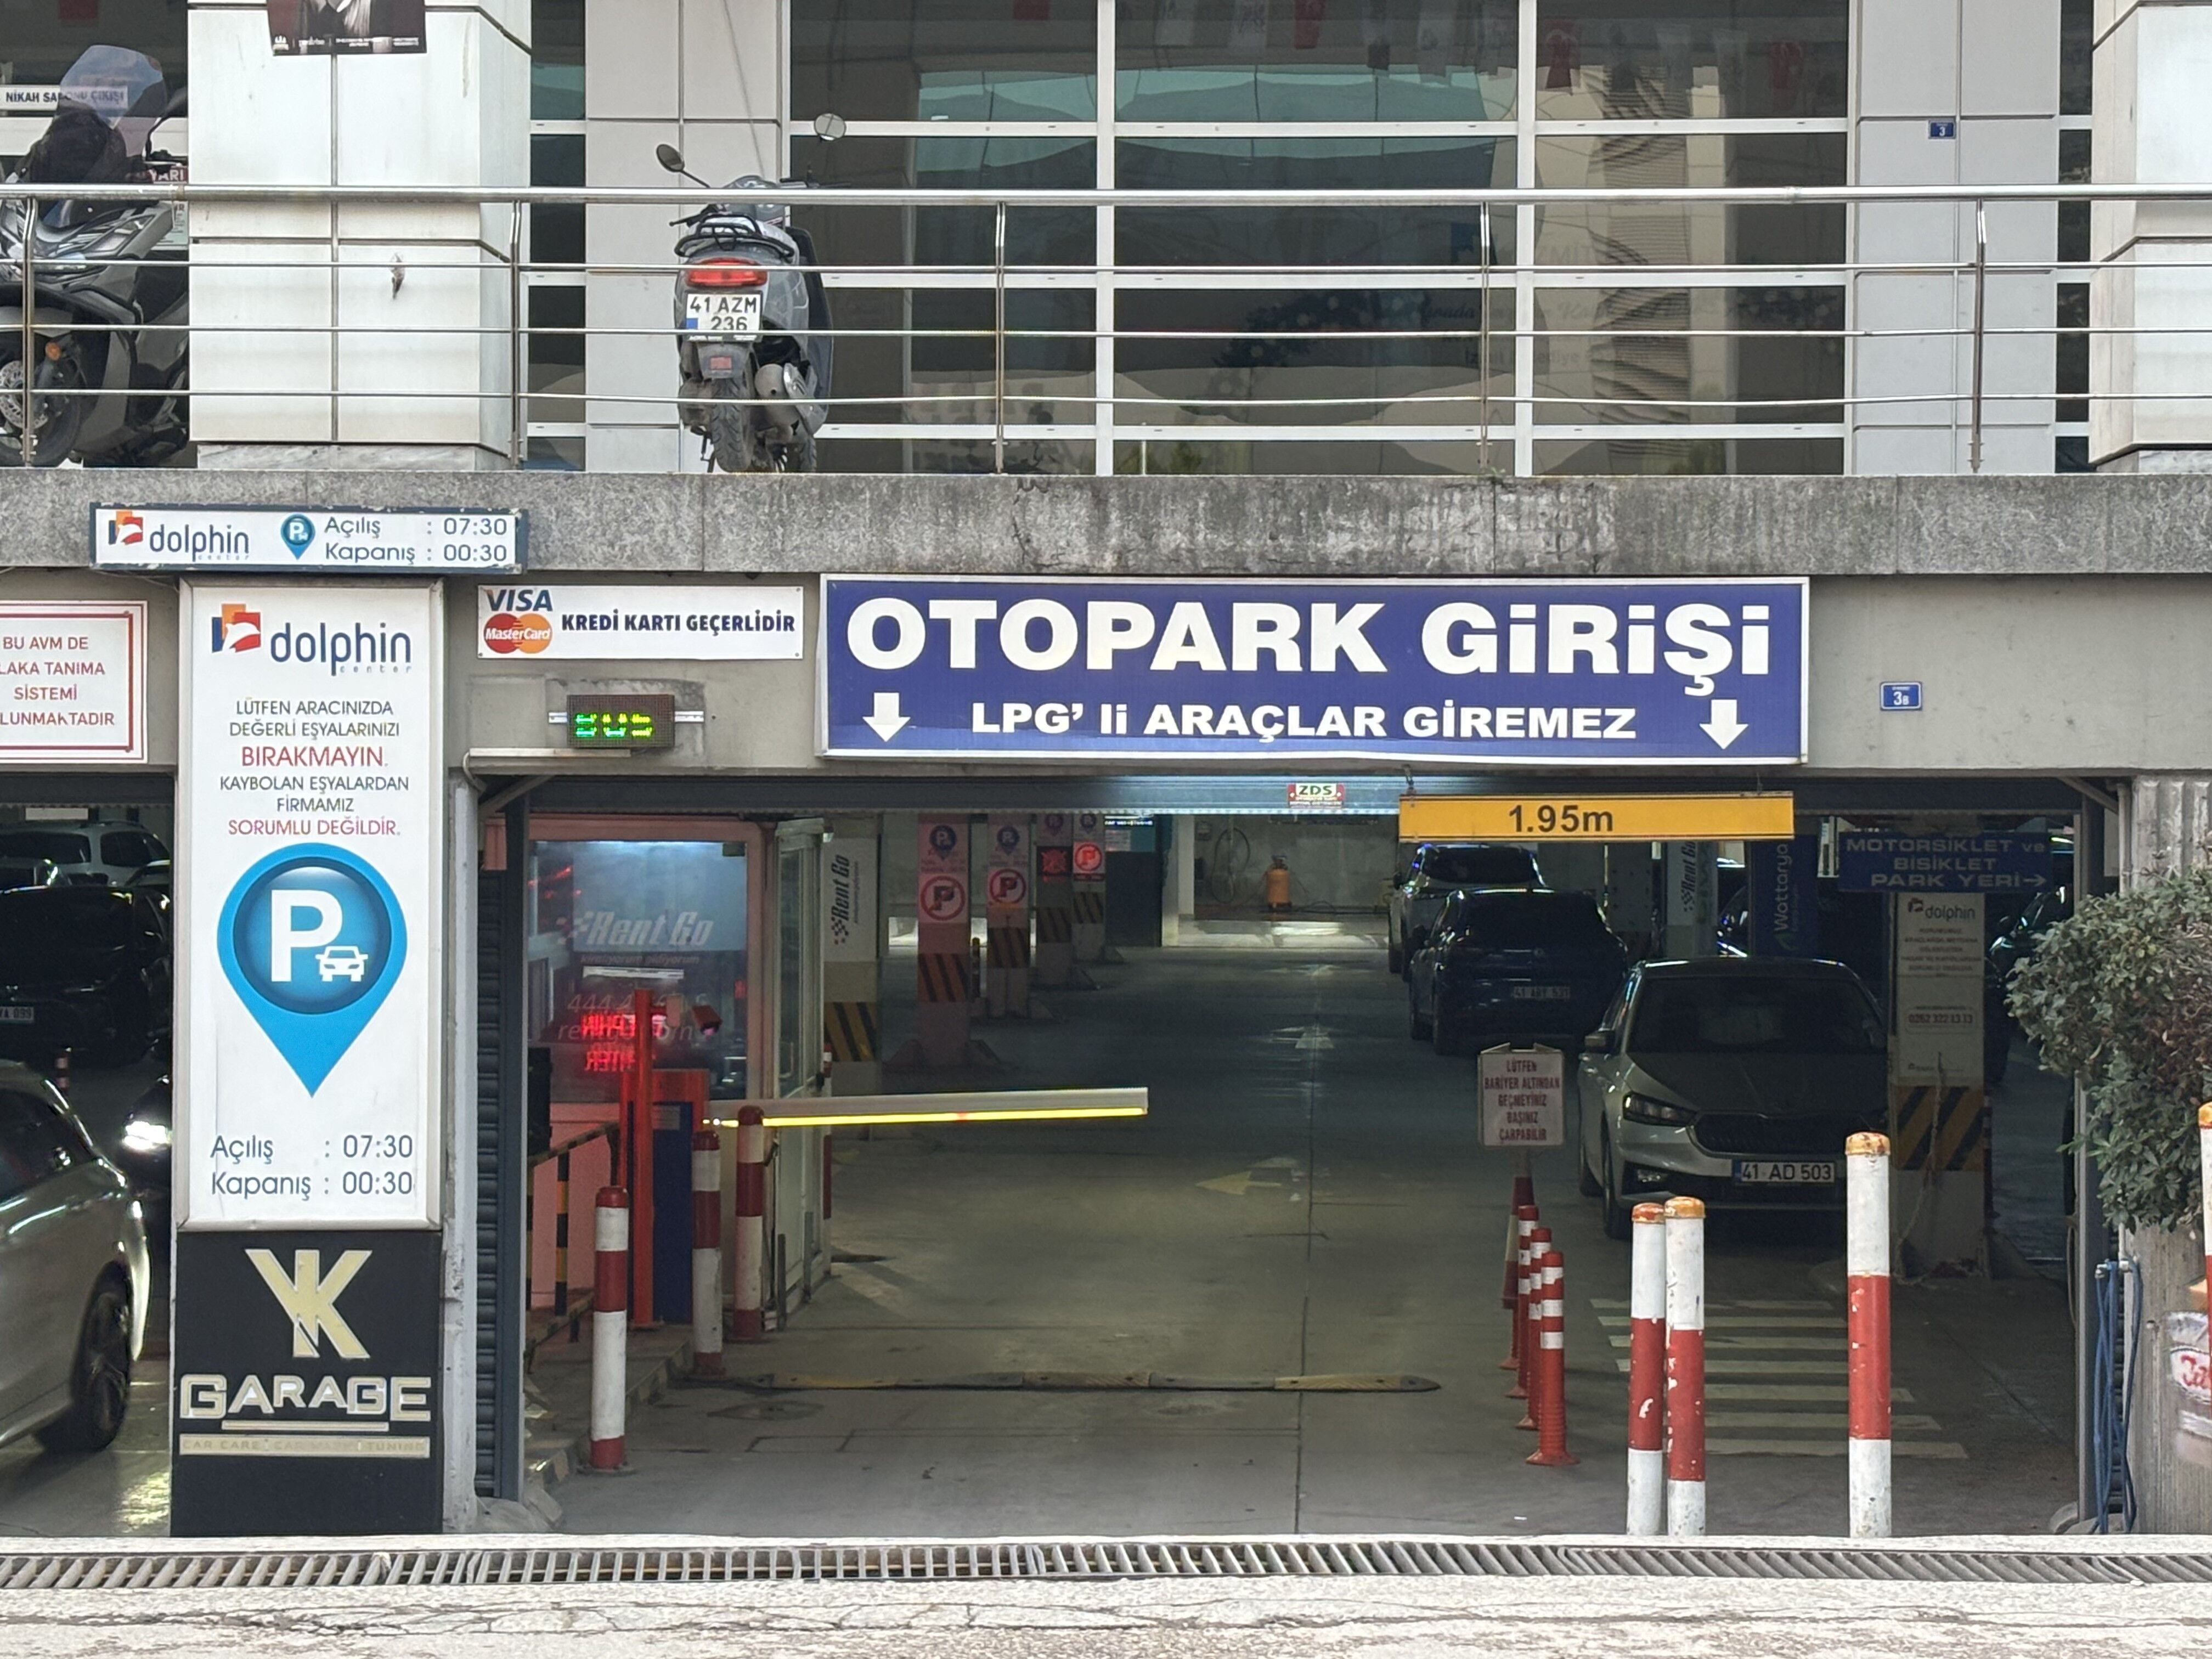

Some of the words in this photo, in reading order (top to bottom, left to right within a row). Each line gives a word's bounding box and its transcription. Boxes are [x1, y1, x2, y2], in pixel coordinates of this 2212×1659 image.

[6, 89, 40, 102] NİKAH
[690, 296, 710, 313] 41
[718, 296, 757, 314] AZM
[710, 316, 748, 330] 236
[324, 517, 381, 538] Açılış
[443, 517, 507, 536] 07:30
[149, 524, 249, 561] dolphin
[325, 542, 415, 564] Kapanış
[443, 544, 507, 562] 00:30
[484, 589, 553, 612] VISA
[561, 608, 619, 631] KREDİ
[624, 613, 680, 631] KARTI
[686, 608, 795, 636] GEÇERLİDİR
[485, 627, 551, 640] MasterCard
[847, 596, 1387, 673] OTOPARK
[3, 636, 25, 650] BU
[29, 636, 63, 650] AVM
[67, 636, 89, 650] DE
[270, 622, 411, 677] dolphin
[44, 662, 105, 675] TANIMA
[340, 664, 412, 674] center
[14, 684, 77, 700] SİSTEMİ
[236, 697, 290, 715] LÜTFEN
[296, 701, 393, 715] ARACINIZDA
[229, 718, 296, 736] DEĞERLİ
[301, 722, 399, 741] EŞYALARINIZI
[1143, 704, 1387, 743] ARAÇLAR
[1403, 699, 1636, 739] GİREMEZ
[220, 776, 304, 791] KAYBOLAN
[310, 776, 409, 794] EŞYALARDAN
[1298, 785, 1333, 795] ZDS
[276, 794, 354, 812] FİRMAMIZ
[229, 820, 311, 835] SORUMLU
[1508, 804, 1613, 833] 1.95m
[2021, 843, 2046, 853] ve
[831, 854, 850, 878] Go
[1871, 874, 1944, 887] PARK
[1958, 872, 2020, 887] YERİ
[831, 878, 850, 922] Rent
[1925, 905, 1976, 922] dolphin
[270, 889, 342, 983] P
[586, 911, 667, 946] Rent
[1506, 1057, 1537, 1073] LÜTFEN
[210, 1134, 274, 1165] Açılış
[342, 1134, 413, 1159] 07:30
[1740, 1163, 1759, 1181] 41
[1768, 1163, 1796, 1181] AD
[1801, 1163, 1831, 1181] 503
[211, 1171, 312, 1201] Kapanış
[342, 1171, 413, 1195] 00:30
[179, 1373, 432, 1422] GARAGE
